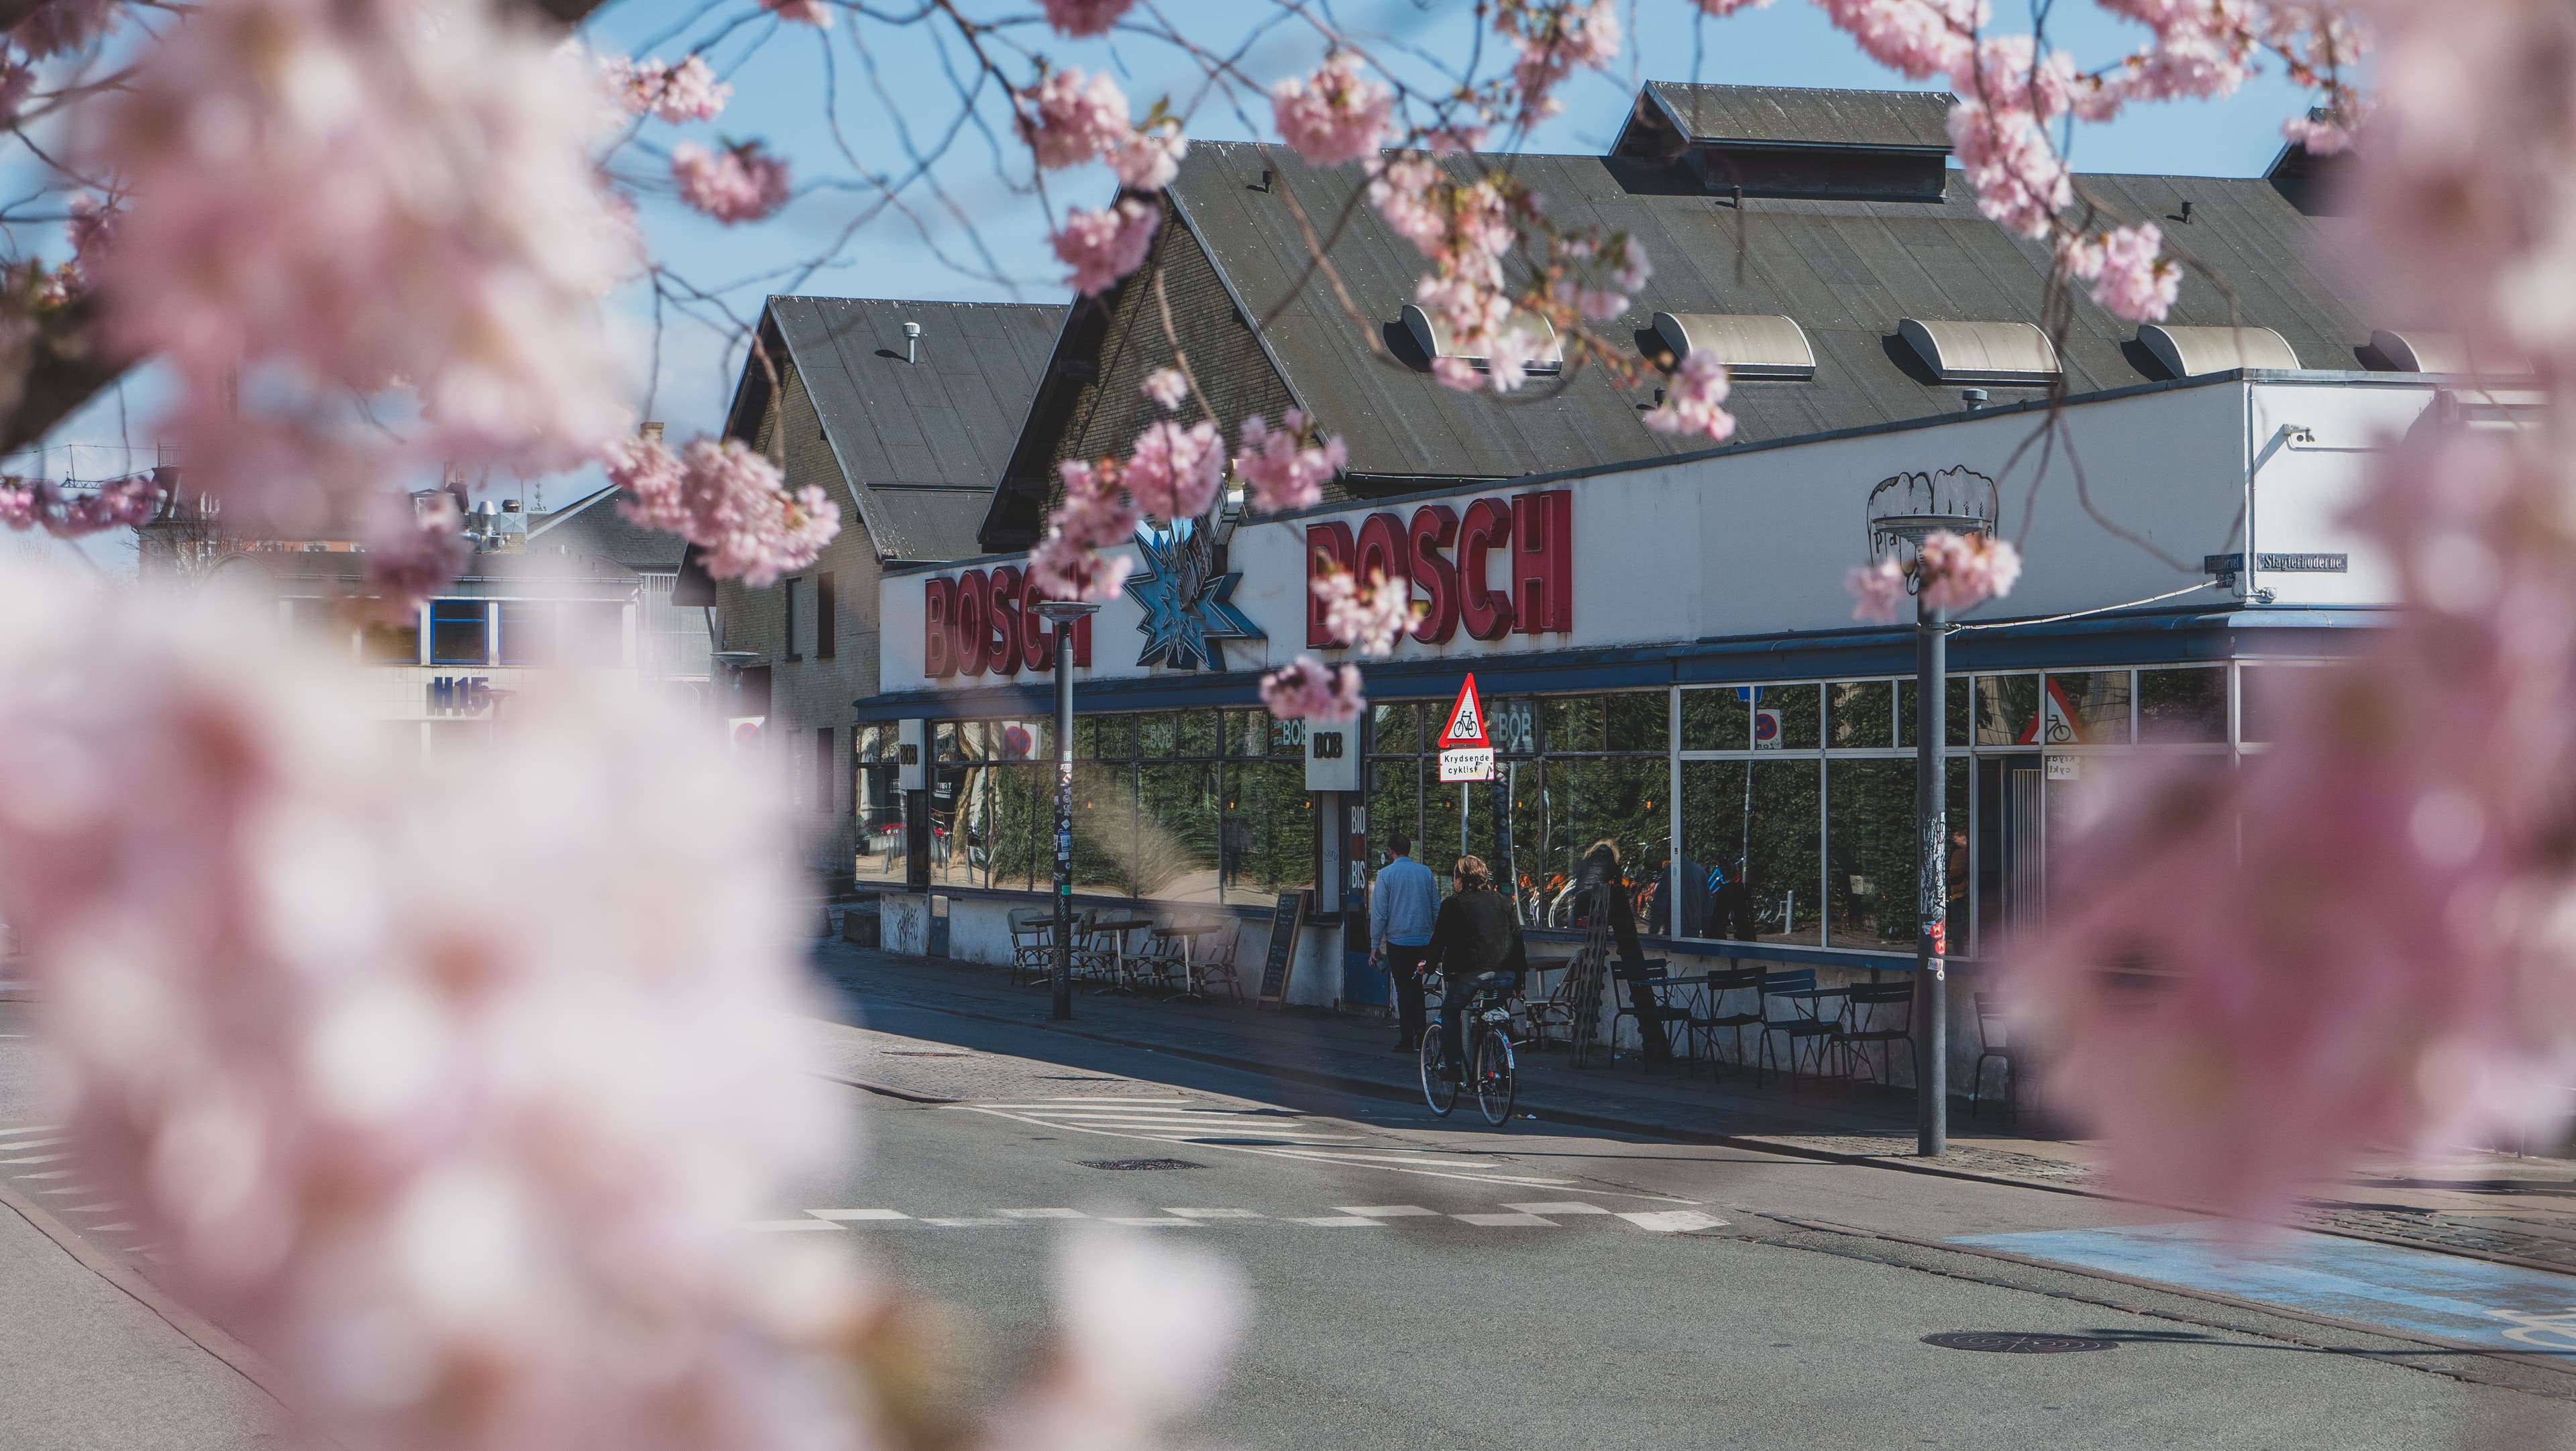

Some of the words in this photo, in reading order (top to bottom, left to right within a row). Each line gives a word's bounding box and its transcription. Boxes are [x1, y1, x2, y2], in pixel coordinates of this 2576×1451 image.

[1306, 490, 1572, 650] BOSCH
[2264, 554, 2341, 570] Slagterboderne
[433, 676, 490, 709] H15
[1499, 712, 1532, 741] BOB
[1313, 732, 1342, 758] BOB
[1444, 754, 1489, 764] Krydsende
[1351, 806, 1365, 835] BIO
[1352, 861, 1366, 889] BIS
